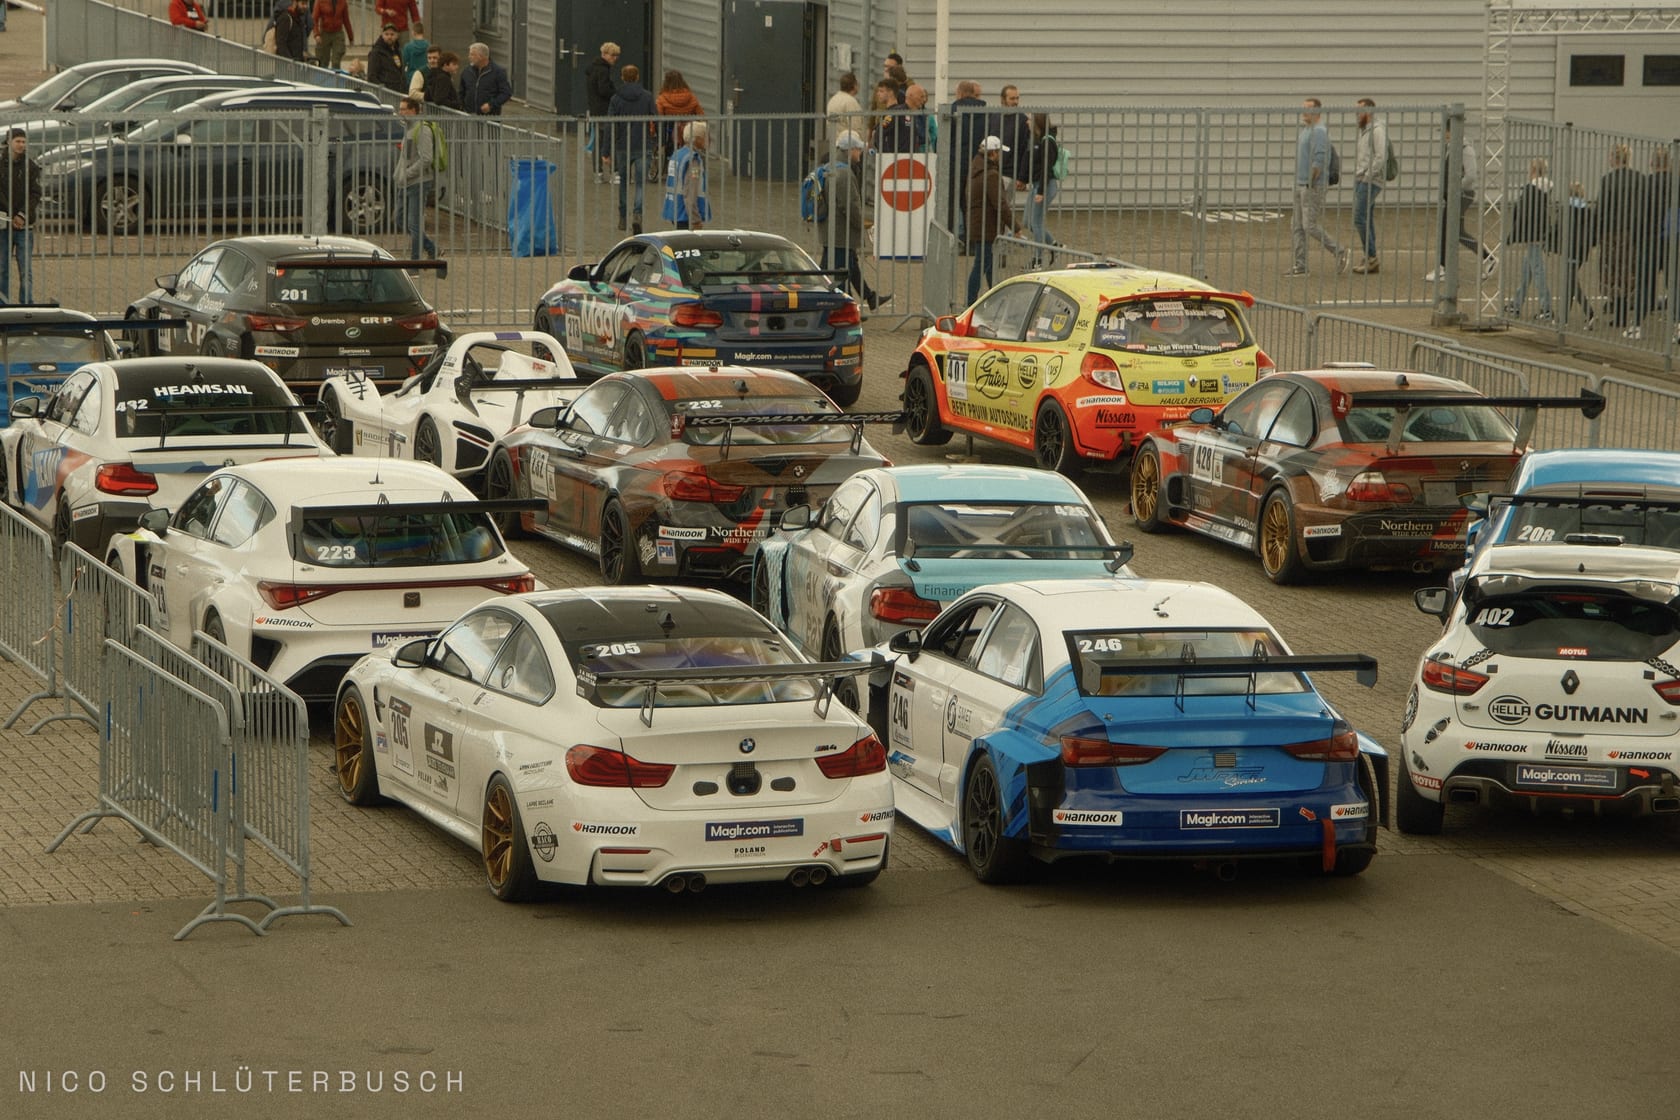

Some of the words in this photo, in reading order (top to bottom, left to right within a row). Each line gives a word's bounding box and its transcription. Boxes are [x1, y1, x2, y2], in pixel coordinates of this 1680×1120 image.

[674, 249, 701, 259] 273
[281, 289, 308, 301] 201
[320, 317, 346, 325] brembo
[1099, 314, 1126, 330] 401
[734, 352, 772, 361] Maglr.com
[947, 360, 967, 384] 401
[153, 384, 254, 397] HEAMS.NL
[688, 400, 722, 410] 232
[1160, 397, 1188, 405] HAULO
[1189, 396, 1224, 404] BERGING
[690, 415, 812, 426] KOOPMAN
[818, 413, 901, 423] RACING
[951, 400, 967, 417] BERT
[968, 402, 989, 421] PRUIM
[989, 407, 1028, 431] AUTOSCHADE
[1095, 408, 1137, 424] Nissens
[1195, 444, 1213, 472] 428
[710, 526, 766, 538] Northern
[1380, 520, 1434, 531] Northern
[317, 545, 356, 561] 223
[1475, 608, 1515, 627] 402
[596, 642, 641, 657] 205
[1078, 638, 1123, 654] 246
[1559, 648, 1588, 656] MOTUL
[893, 692, 909, 731] 246
[1492, 704, 1531, 717] HELLA
[1535, 703, 1649, 724] GUTMANN
[391, 711, 409, 750] 205
[1544, 739, 1589, 756] Nissens
[1413, 774, 1442, 790] MOTUL
[1522, 768, 1582, 783] Maglr.com
[1186, 813, 1246, 827] Maglr.com
[710, 824, 771, 839] Maglr.com
[734, 845, 766, 854] POLAND
